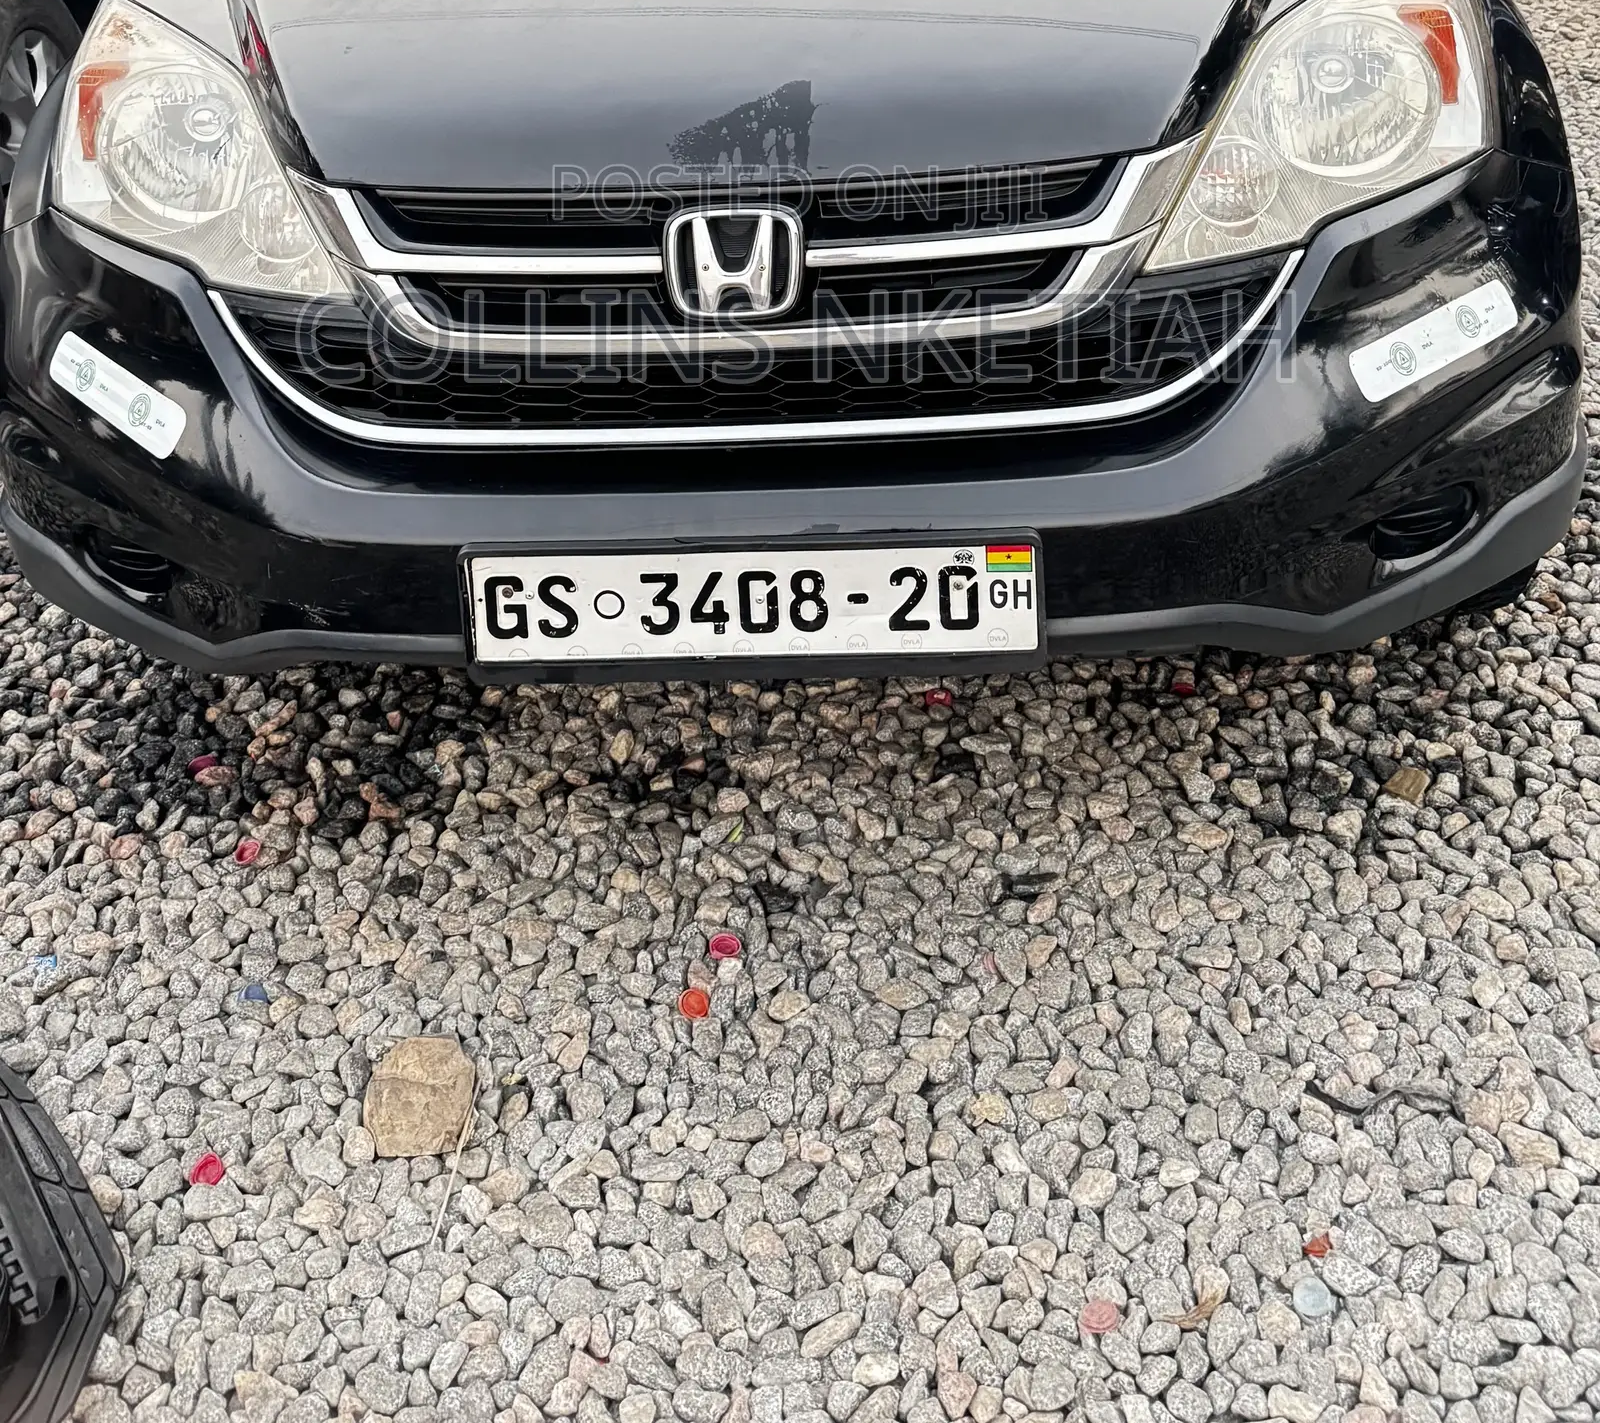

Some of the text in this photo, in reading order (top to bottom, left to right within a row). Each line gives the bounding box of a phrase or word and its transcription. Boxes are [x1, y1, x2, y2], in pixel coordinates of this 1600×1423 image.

[484, 575, 579, 640] GS
[989, 579, 1032, 610] GH
[989, 634, 1007, 642] DVLA
